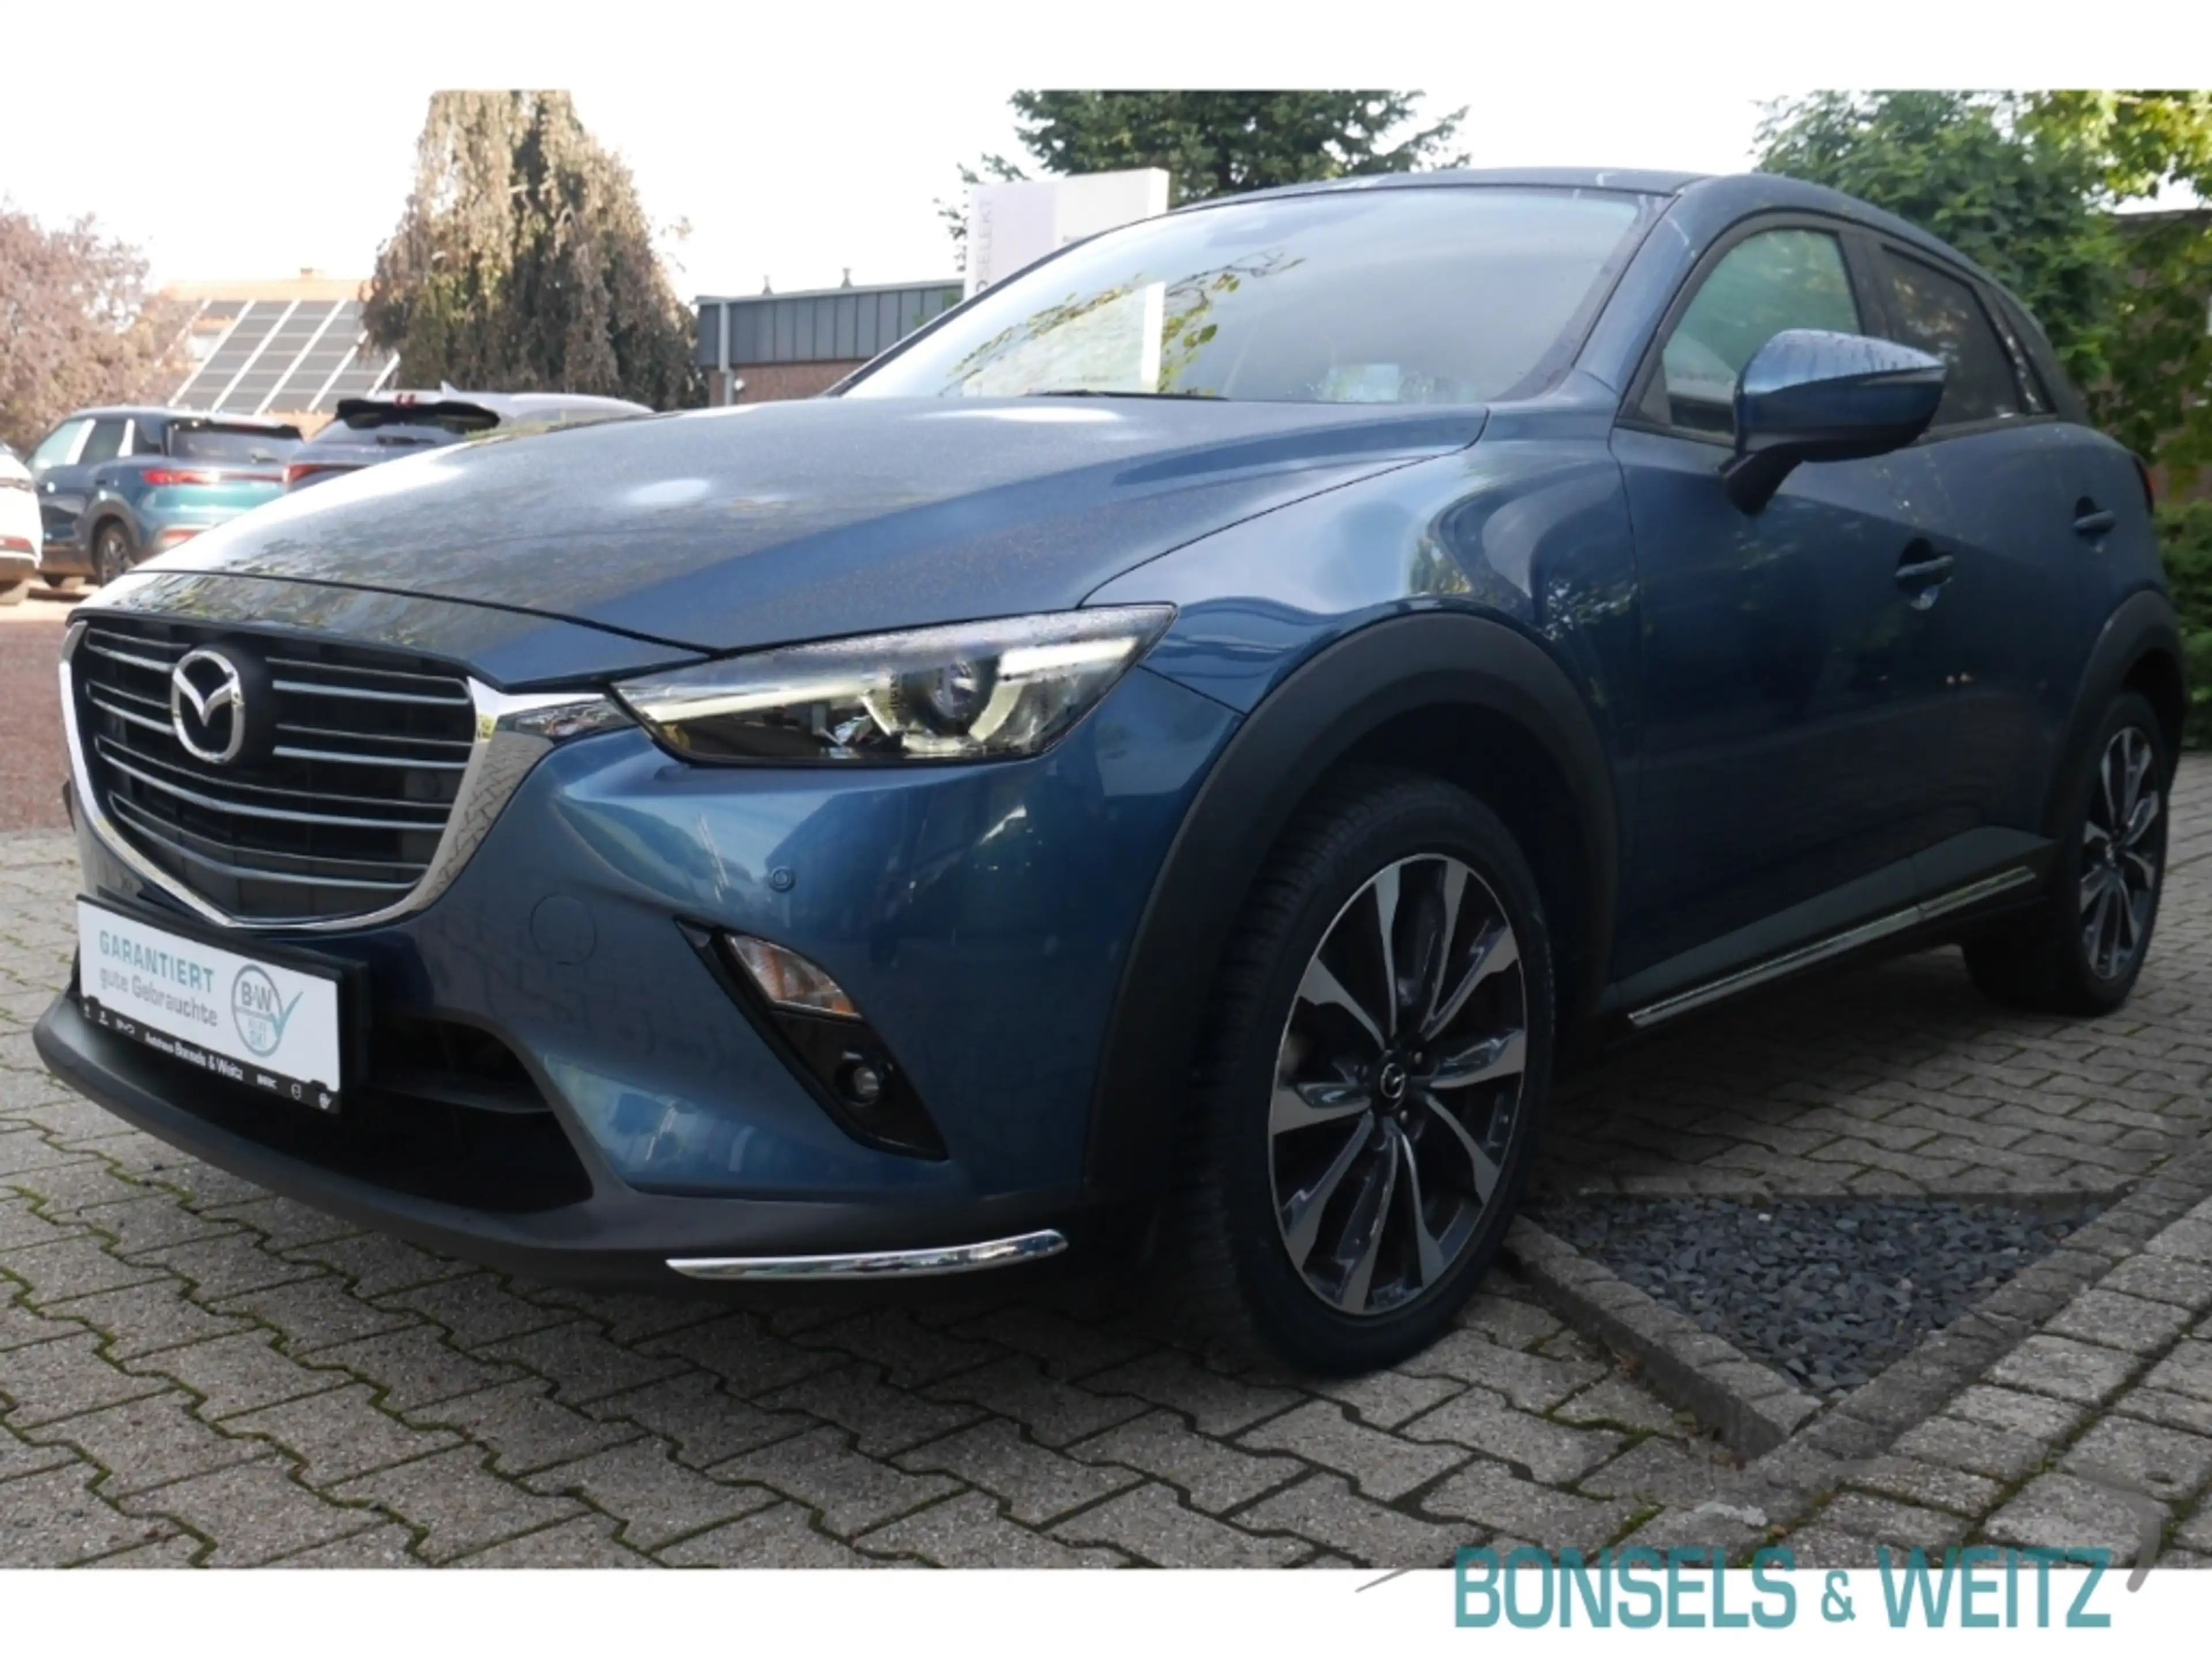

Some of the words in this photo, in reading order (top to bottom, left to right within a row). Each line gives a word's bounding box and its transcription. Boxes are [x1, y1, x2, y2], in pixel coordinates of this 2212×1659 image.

[99, 929, 215, 994] GARANTIERT
[99, 967, 128, 991] gute
[131, 974, 218, 1027] Gebrauchte
